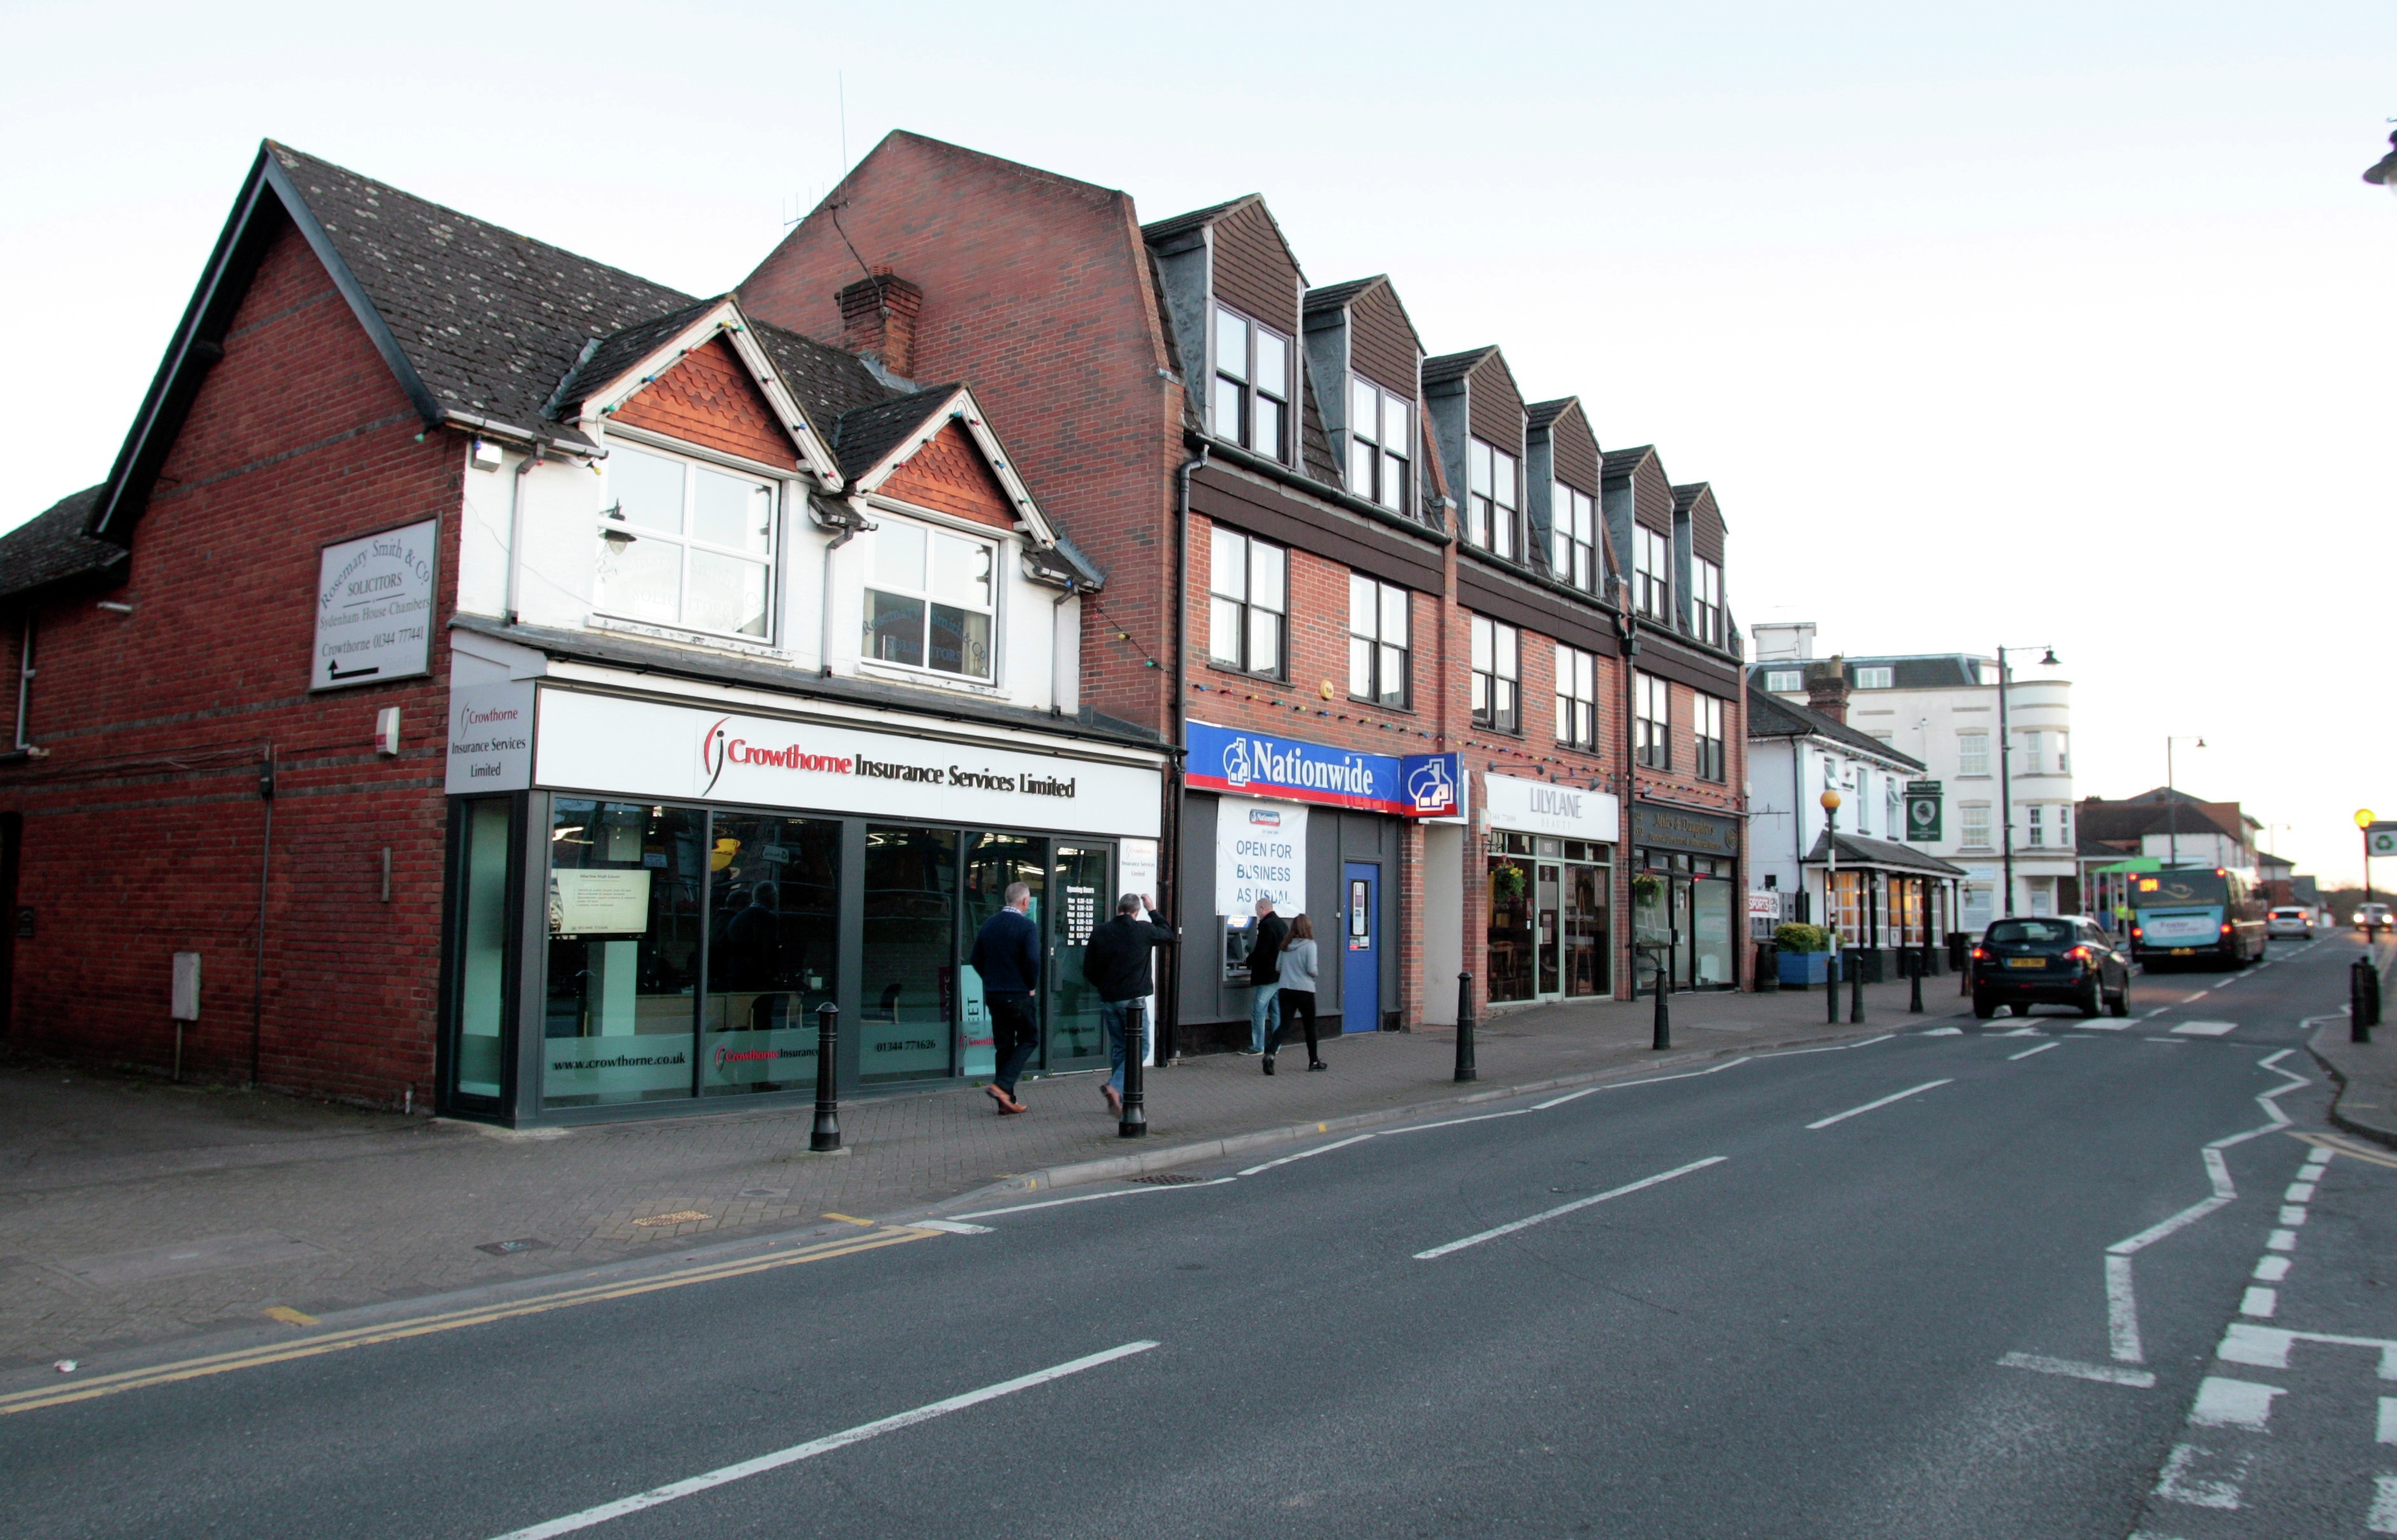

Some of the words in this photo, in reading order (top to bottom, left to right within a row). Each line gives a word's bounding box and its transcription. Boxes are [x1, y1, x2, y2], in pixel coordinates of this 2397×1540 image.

[320, 548, 368, 609] Rosemary
[372, 539, 402, 559] Smith
[405, 548, 416, 567] &
[348, 572, 402, 597] SOLICITORS
[320, 612, 359, 630] Sydenham
[362, 607, 387, 622] House
[389, 597, 430, 616] Chambers
[322, 639, 370, 657] Crowthorne
[373, 632, 395, 648] 01344
[469, 708, 518, 724] Crowthorne
[452, 741, 489, 754] Insurance
[491, 737, 526, 751] Services
[470, 762, 501, 777] Limited
[728, 738, 853, 775] Crowthorne
[855, 753, 944, 785] Insurance
[949, 765, 1015, 792] Services
[1019, 773, 1076, 799] Limited
[1252, 740, 1374, 795] Nationwide
[1530, 787, 1583, 819] LILYLANE
[1541, 818, 1570, 830] BEAUTY
[1236, 840, 1267, 857] OPEN
[1271, 844, 1292, 859] FOR
[1236, 864, 1291, 882] BUSINESS
[1237, 888, 1252, 903] AS
[1255, 889, 1291, 905] USUAL
[1749, 898, 1769, 910] SPORTS
[877, 1041, 902, 1052] 01344
[905, 1039, 936, 1050] 771626
[553, 1051, 685, 1071] www.crowthorne.co.uk
[726, 1049, 778, 1063] Crowthorne
